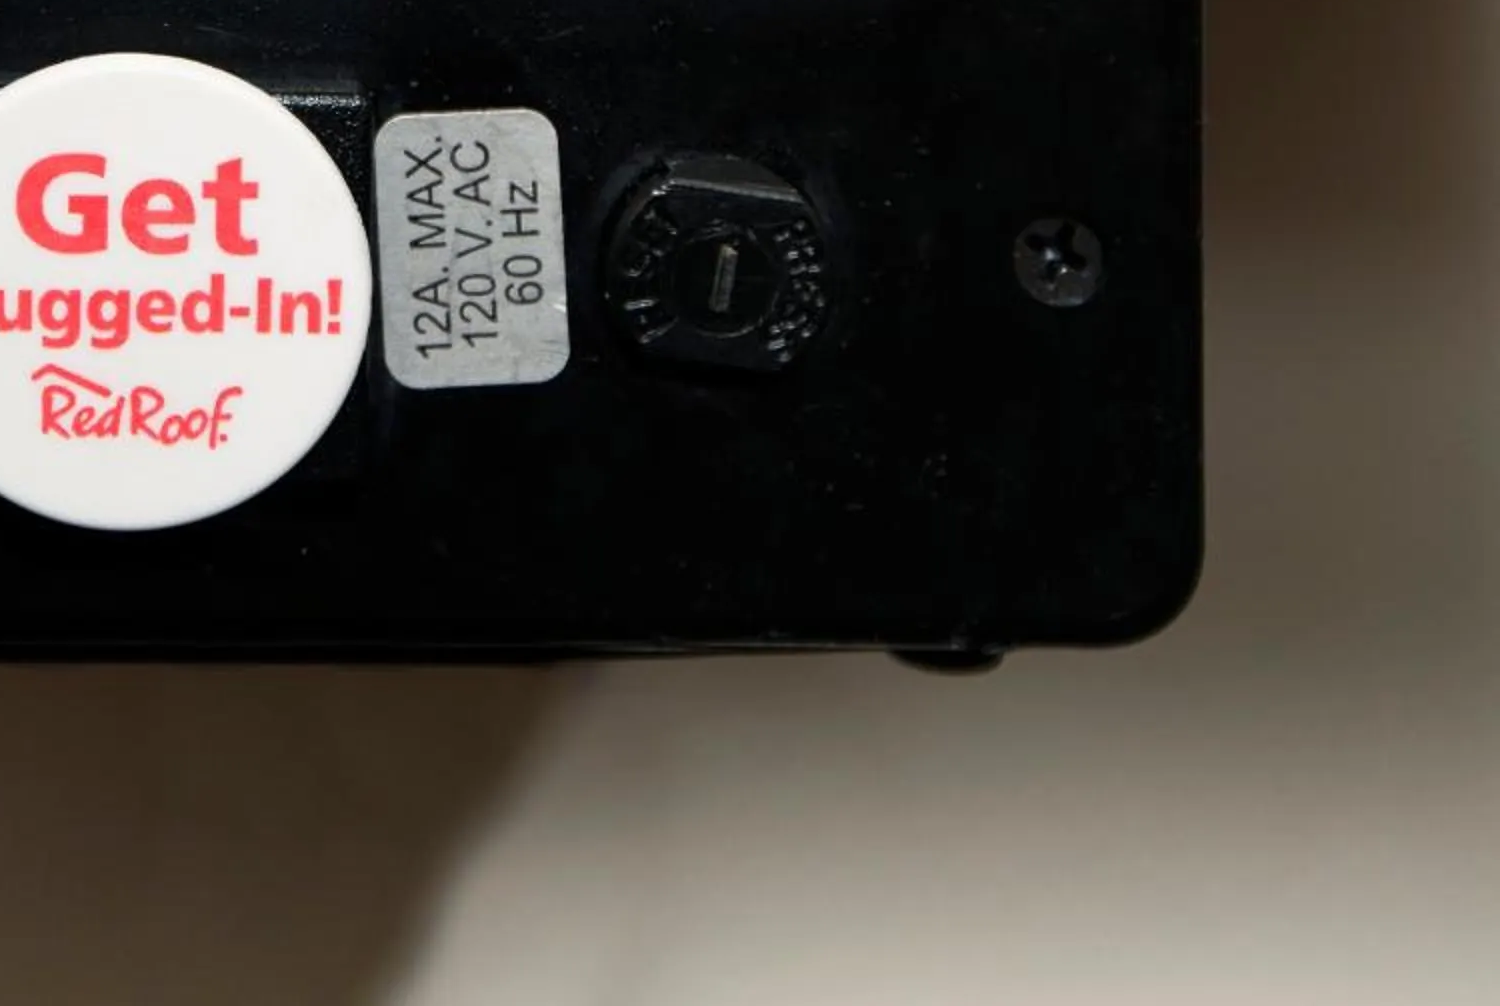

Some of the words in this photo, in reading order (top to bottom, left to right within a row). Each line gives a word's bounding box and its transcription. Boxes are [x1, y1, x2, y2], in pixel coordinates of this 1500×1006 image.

[14, 151, 260, 257] Get
[403, 136, 448, 251] MAX.
[499, 180, 541, 239] Hz
[412, 266, 453, 360] 12A.
[456, 273, 499, 348] 120
[502, 254, 545, 307] 60
